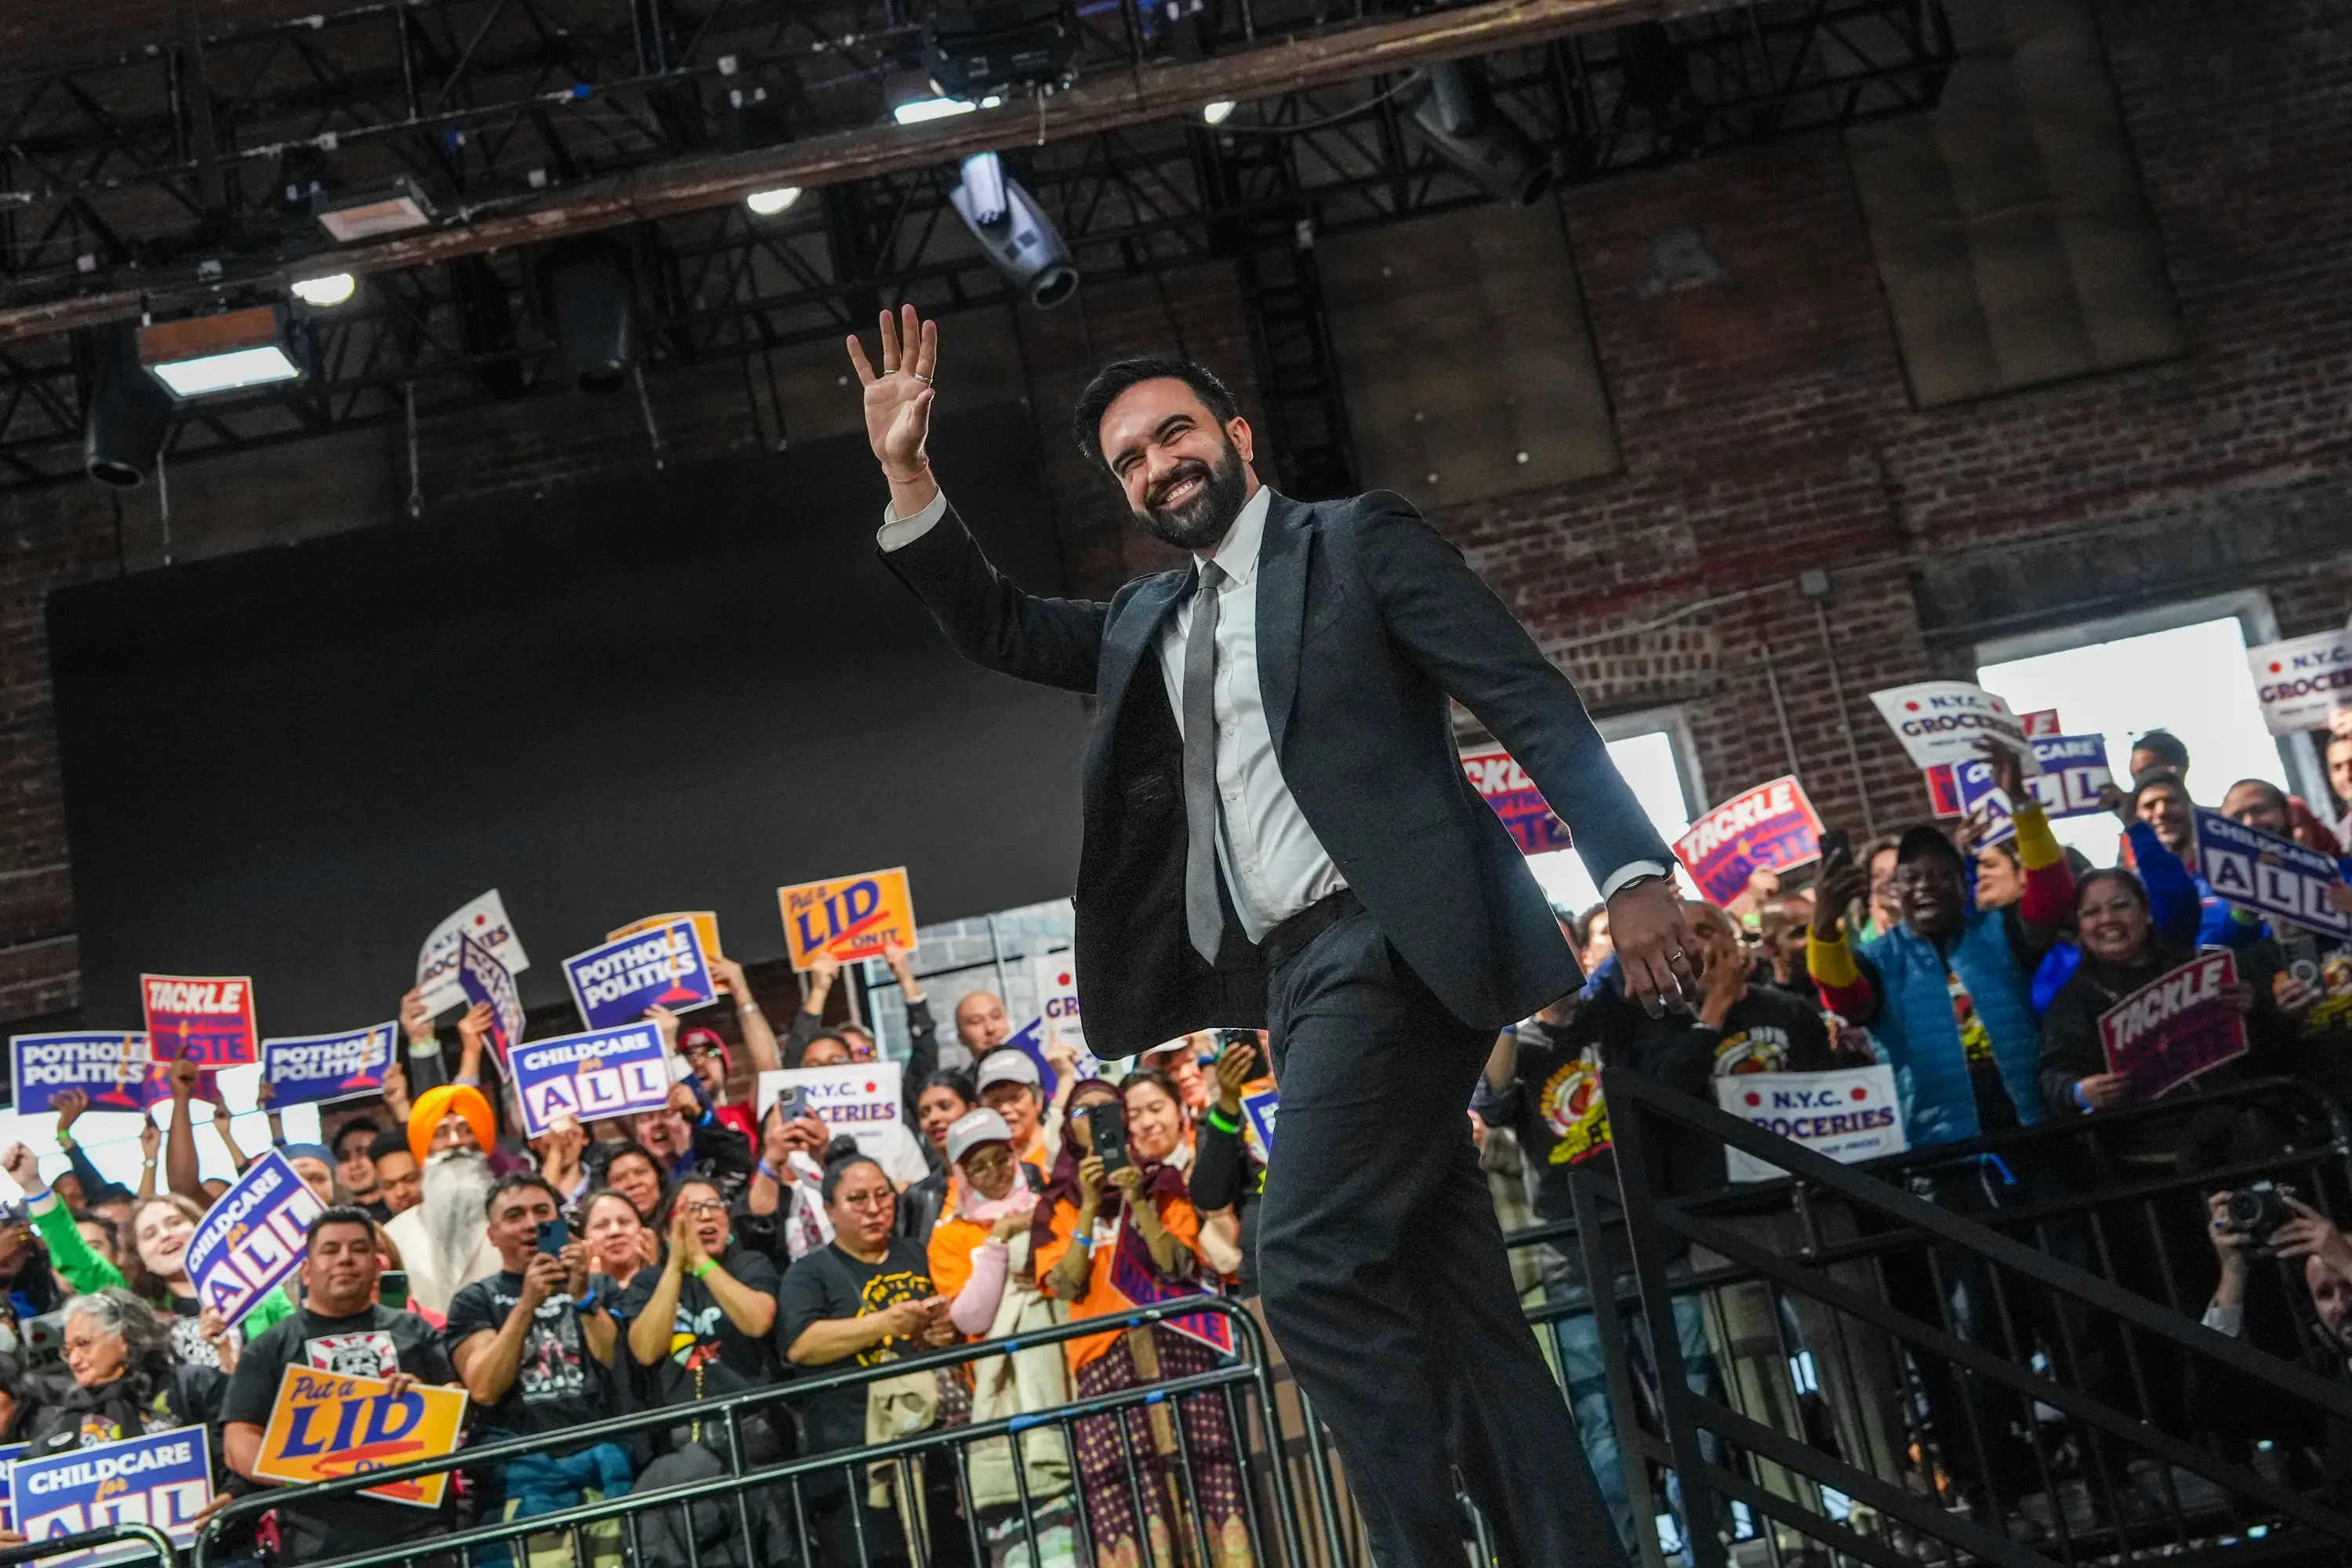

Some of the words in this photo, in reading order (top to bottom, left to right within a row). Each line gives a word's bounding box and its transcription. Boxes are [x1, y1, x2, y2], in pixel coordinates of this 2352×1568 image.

[1680, 784, 1795, 865] TACKLE
[797, 880, 880, 958] LID
[575, 931, 691, 989] POTHOLE
[583, 951, 698, 1010] POLITICS
[147, 981, 244, 1014] TACKLE
[2111, 959, 2225, 1051] TACKLE
[23, 1062, 145, 1087] POLITICS
[271, 1031, 387, 1066] POTHOLE
[271, 1048, 387, 1084] POLITICS
[524, 1032, 652, 1071] CHILDCARE
[543, 1065, 658, 1117] ALL
[816, 1102, 896, 1123] CERIES
[1773, 1091, 1842, 1109] N.Y.C.
[188, 1167, 283, 1273] CHILDCARE
[210, 1206, 309, 1314] ALL
[290, 1377, 335, 1402] Put
[338, 1380, 356, 1397] a
[276, 1390, 425, 1461] LID
[28, 1441, 193, 1495] CHILDCARE
